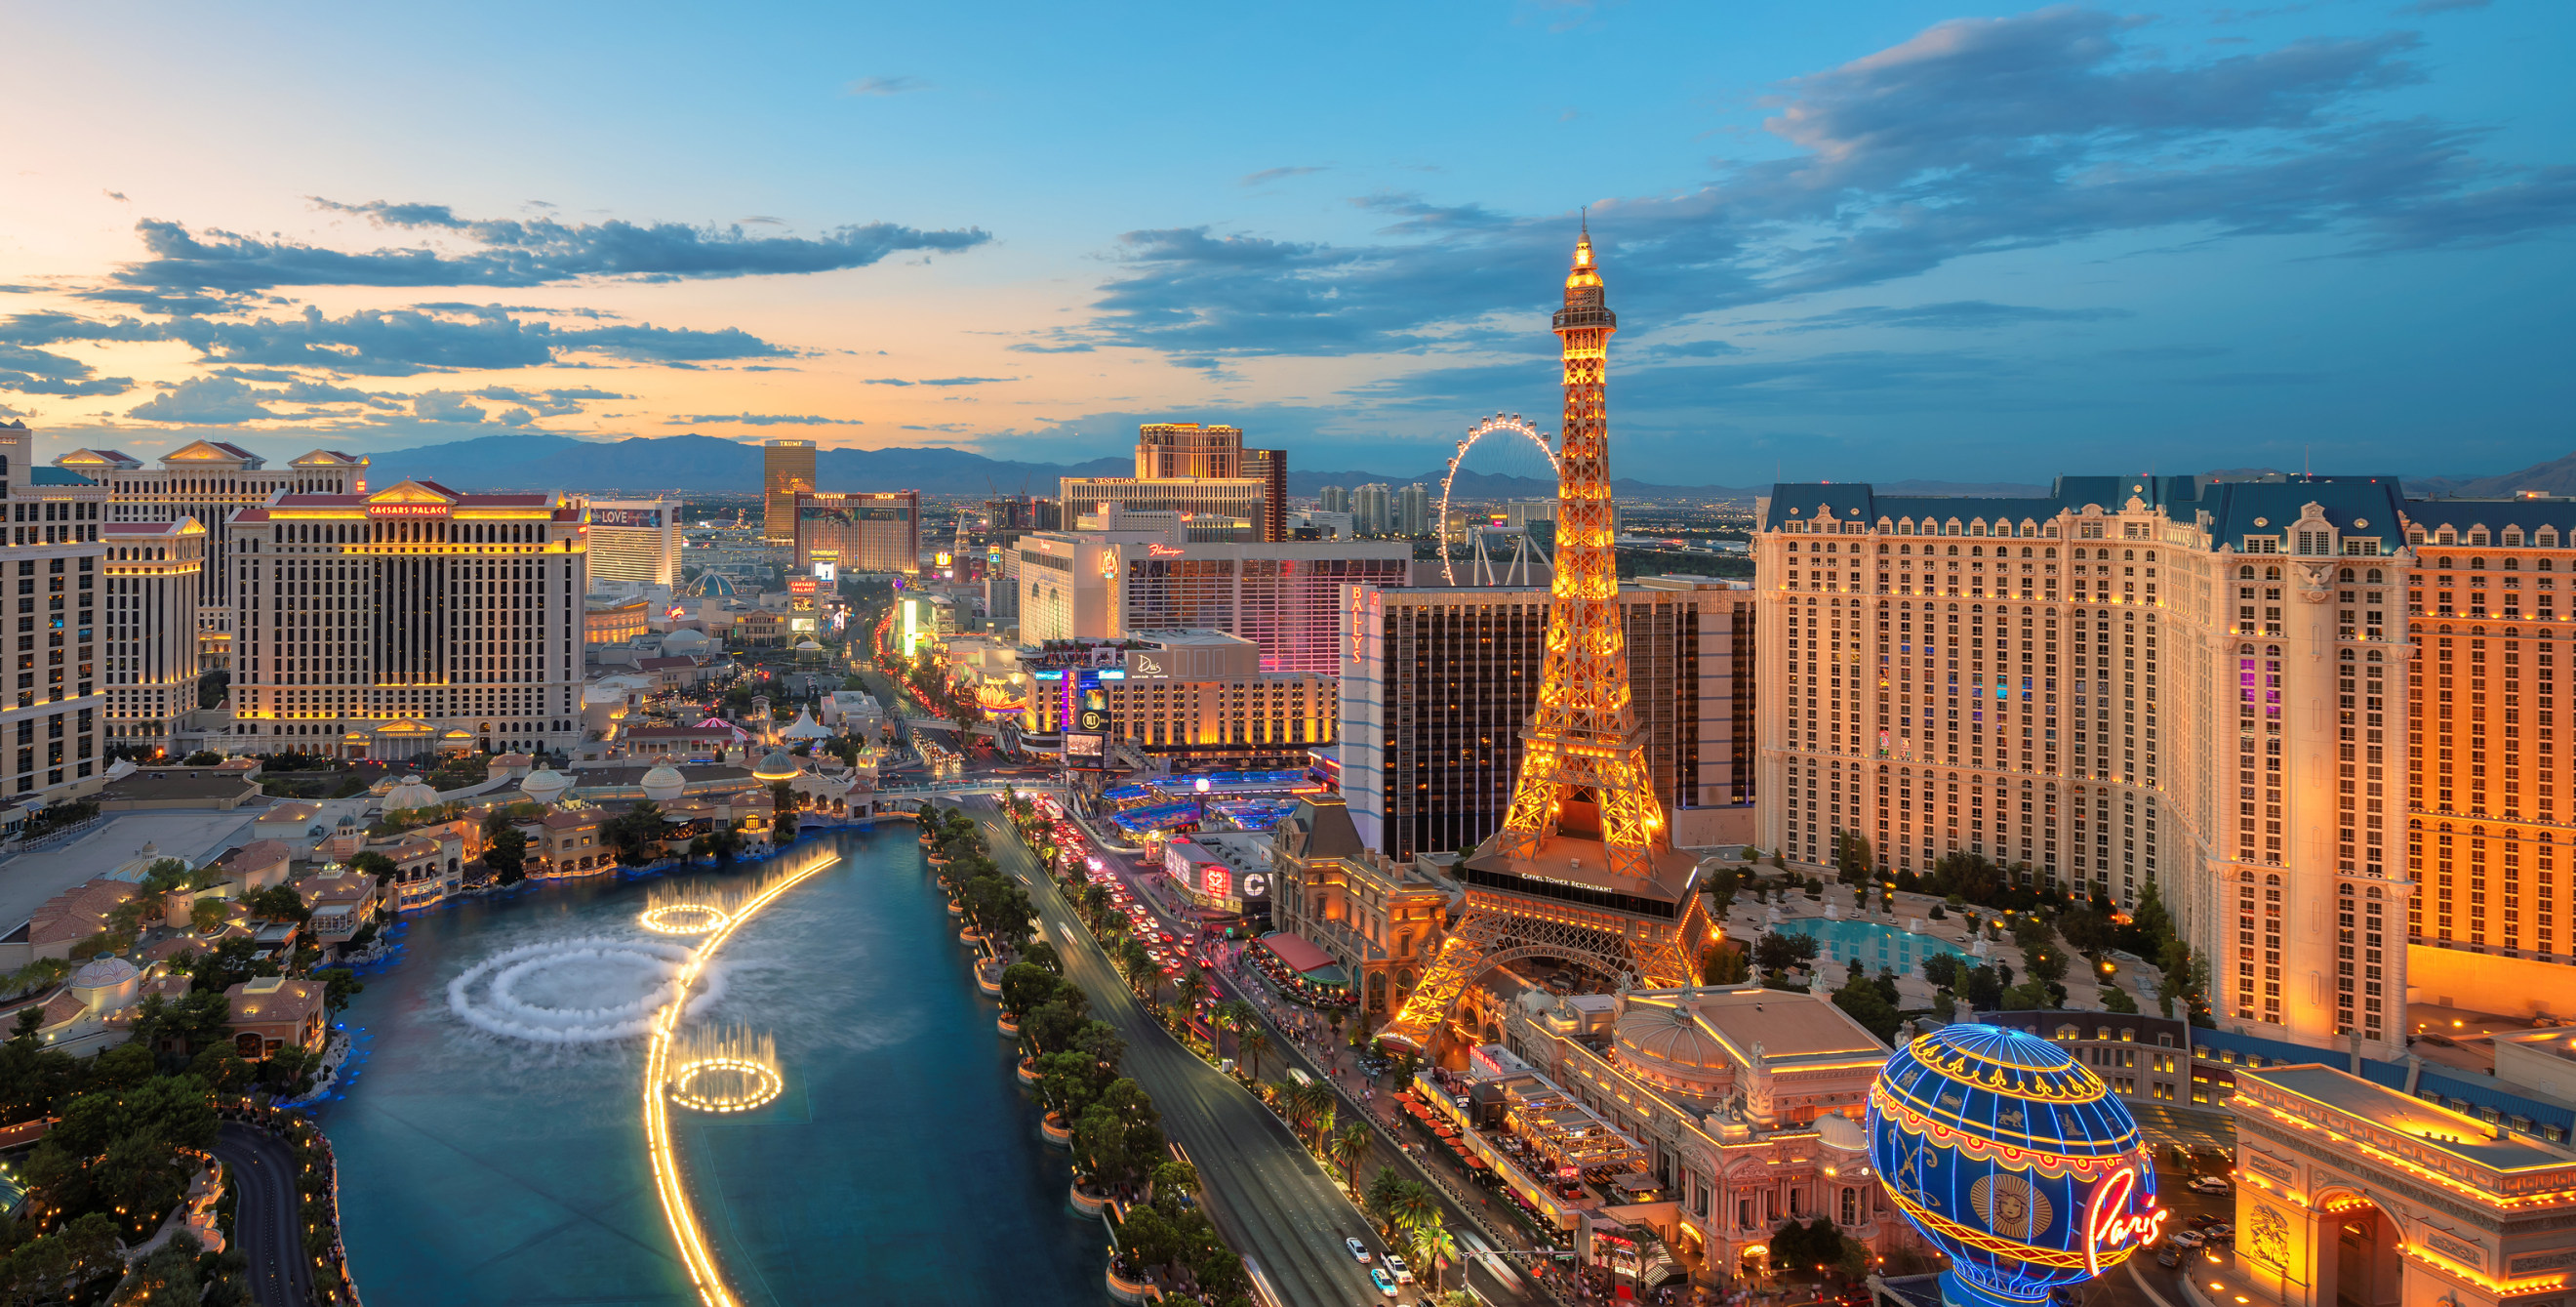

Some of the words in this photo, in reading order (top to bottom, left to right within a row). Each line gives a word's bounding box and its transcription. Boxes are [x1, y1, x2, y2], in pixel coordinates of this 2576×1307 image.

[369, 506, 410, 514] CAESARS
[412, 506, 447, 514] PALACE
[602, 511, 627, 524] LOVE
[1148, 543, 1185, 557] Flamingo
[1086, 715, 1096, 726] BLT
[1521, 873, 1545, 882] EIFFEL
[1545, 876, 1568, 886] TOWER
[1571, 880, 1613, 893] RESTAURANT
[1399, 1035, 1412, 1043] BAR
[1469, 1044, 1485, 1063] BEER
[1485, 1057, 1502, 1075] PARK
[2084, 1166, 2168, 1278] Paris
